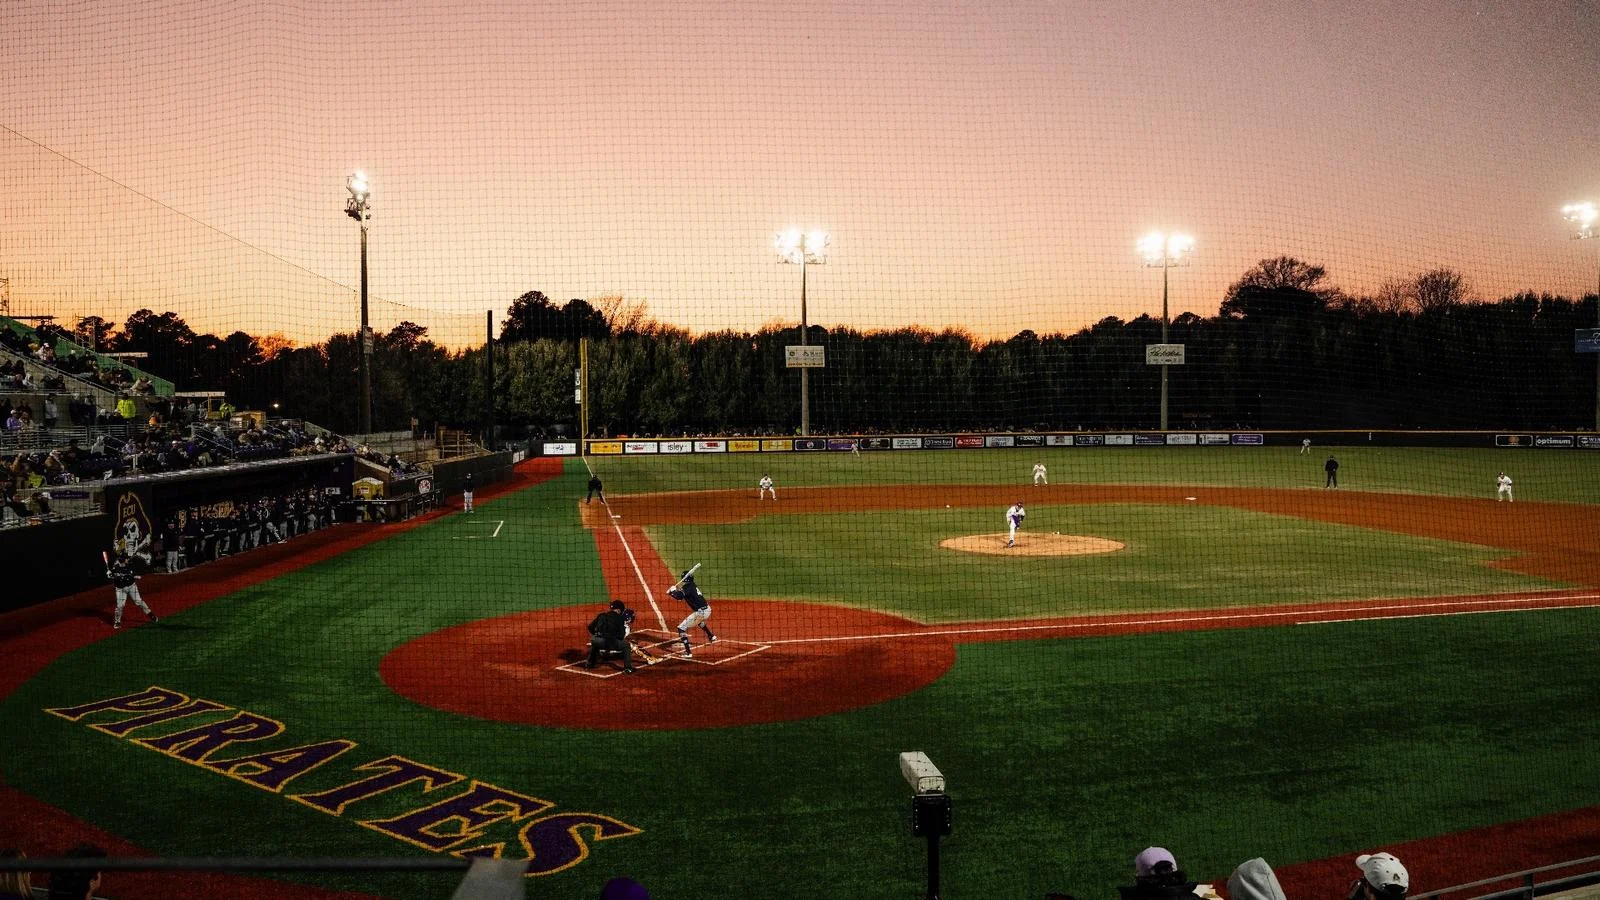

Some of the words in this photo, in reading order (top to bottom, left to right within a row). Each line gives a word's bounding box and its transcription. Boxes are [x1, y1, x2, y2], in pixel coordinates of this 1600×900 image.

[1537, 437, 1571, 445] optimum
[122, 504, 136, 518] ECU
[44, 686, 645, 877] PIRATES
